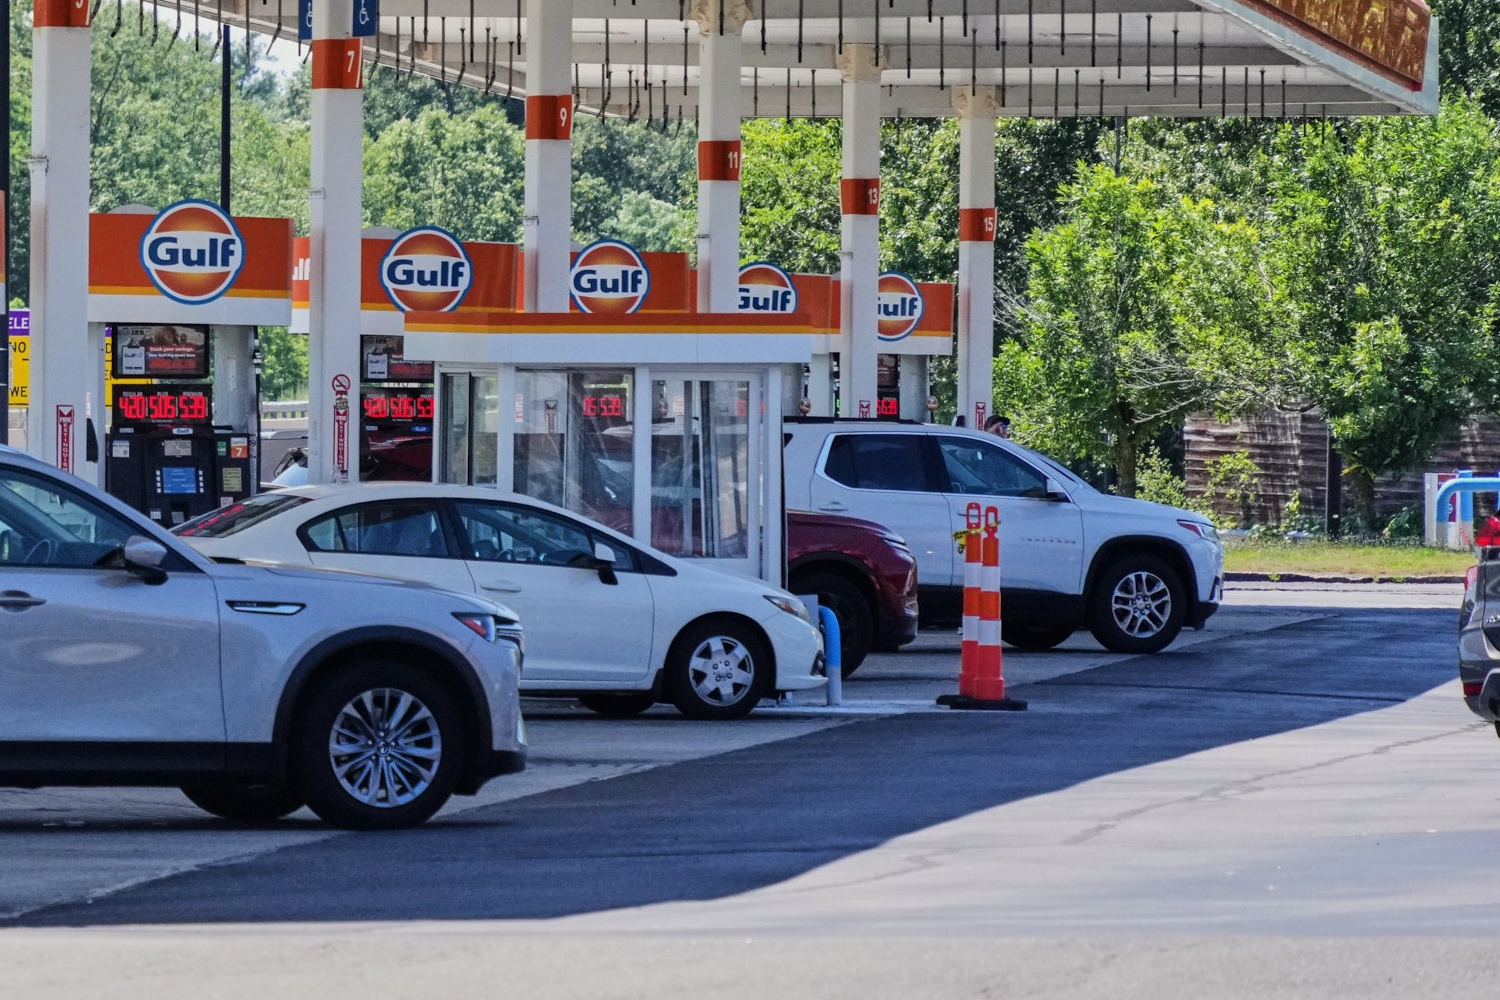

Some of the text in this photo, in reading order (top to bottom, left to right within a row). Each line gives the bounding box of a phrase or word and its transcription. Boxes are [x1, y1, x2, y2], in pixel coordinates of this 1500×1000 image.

[347, 51, 355, 72] 7
[560, 107, 567, 127] 9
[728, 151, 738, 168] 11
[867, 188, 878, 204] 13
[984, 216, 993, 232] 15
[148, 236, 236, 267] Gulf
[387, 259, 465, 287] Gulf
[573, 269, 642, 293] Gulf
[878, 296, 918, 317] ulf
[235, 447, 243, 457] 7
